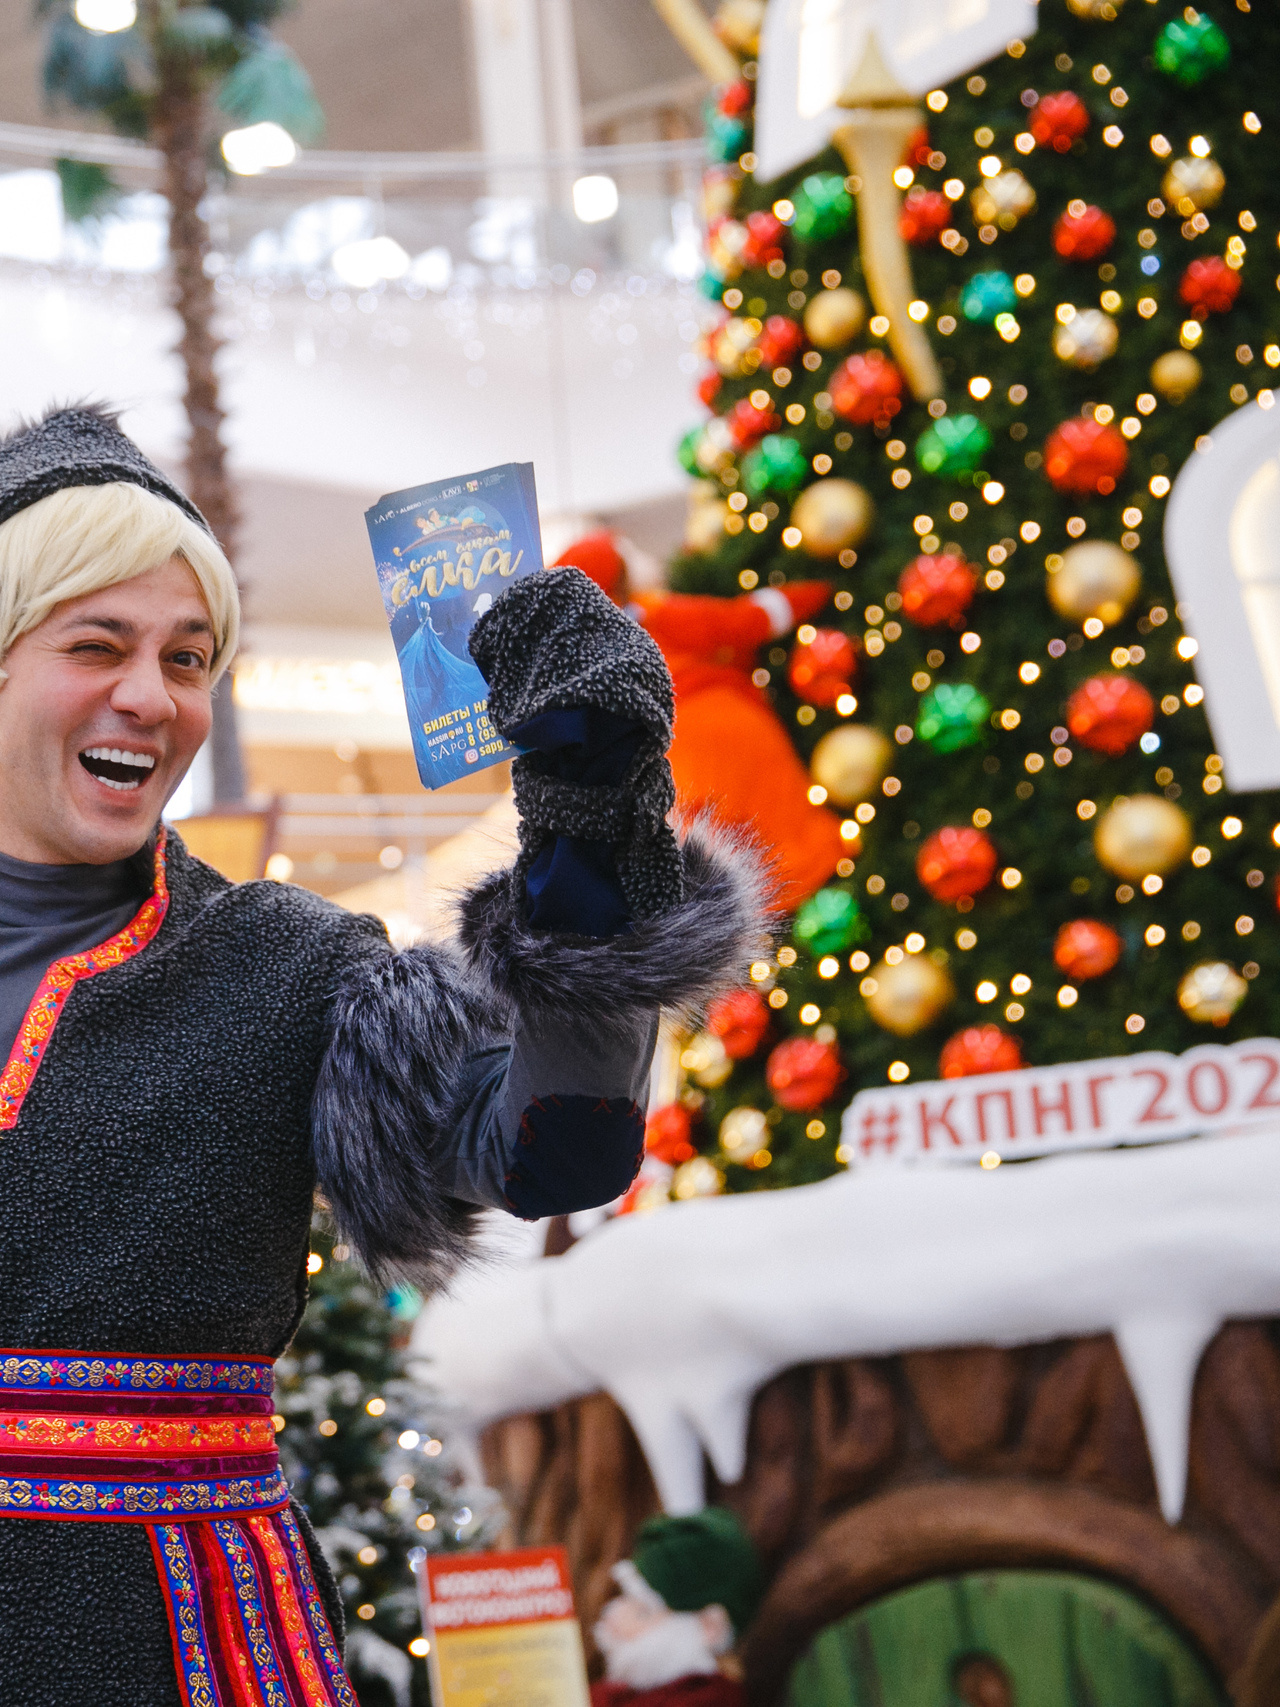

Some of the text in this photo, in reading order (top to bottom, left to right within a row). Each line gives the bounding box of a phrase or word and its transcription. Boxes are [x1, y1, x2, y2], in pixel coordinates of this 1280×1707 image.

[423, 706, 470, 735] БИЛЕТЫ
[465, 721, 474, 734] 8
[467, 734, 476, 747] 8
